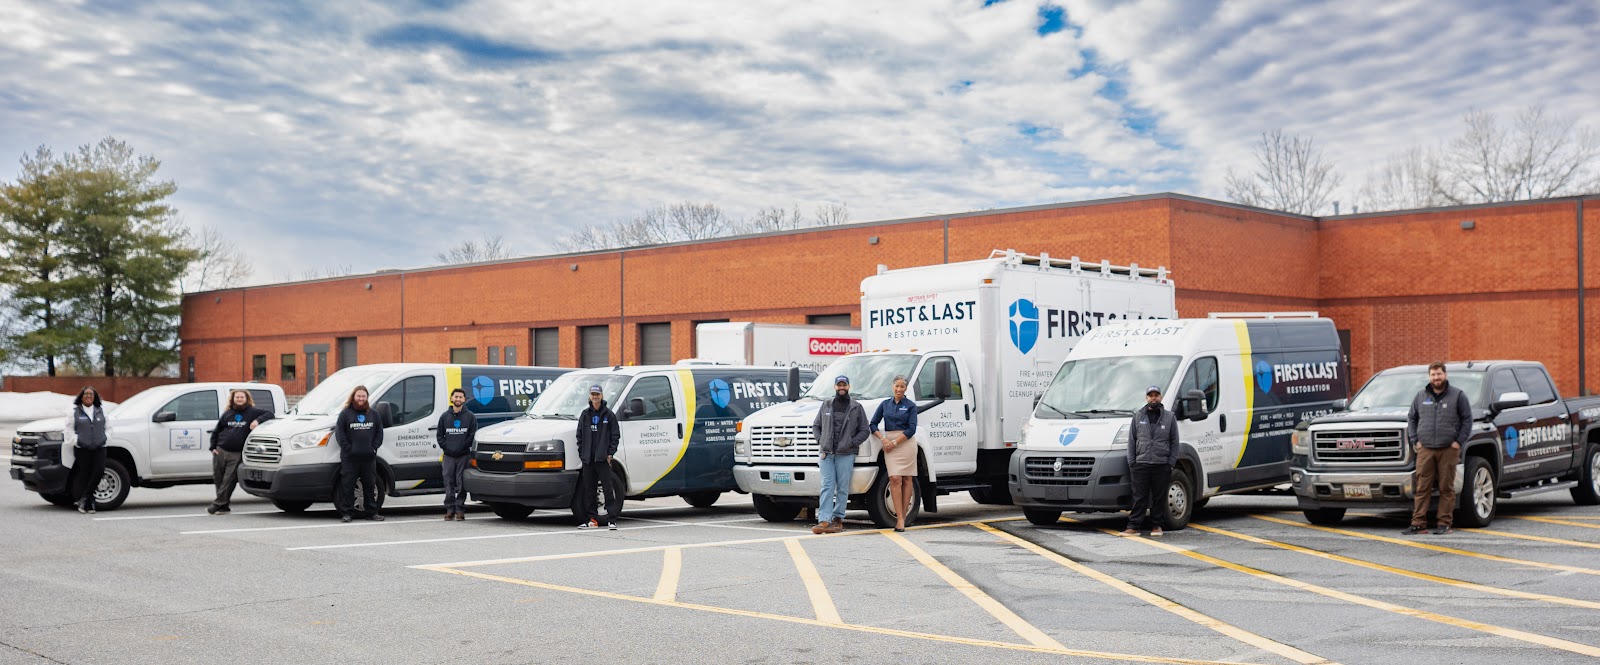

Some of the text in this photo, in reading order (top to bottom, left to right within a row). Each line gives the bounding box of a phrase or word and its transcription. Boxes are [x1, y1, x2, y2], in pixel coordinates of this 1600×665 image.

[870, 301, 976, 328] FIRST & LAST
[1047, 309, 1105, 338] FIRST
[888, 327, 958, 338] RESTORATION
[1142, 327, 1184, 336] LAST
[810, 339, 861, 352] Goodman
[1274, 363, 1304, 383] FIRST
[1312, 362, 1338, 379] LAST
[499, 380, 543, 396] FIRST
[733, 382, 771, 399] FIRST
[773, 382, 783, 396] &
[1287, 384, 1331, 394] RESTORATION
[1519, 427, 1541, 449] FIRST
[1548, 423, 1567, 441] LAST
[1336, 439, 1375, 449] GMC
[1527, 446, 1560, 457] RESTORATION
